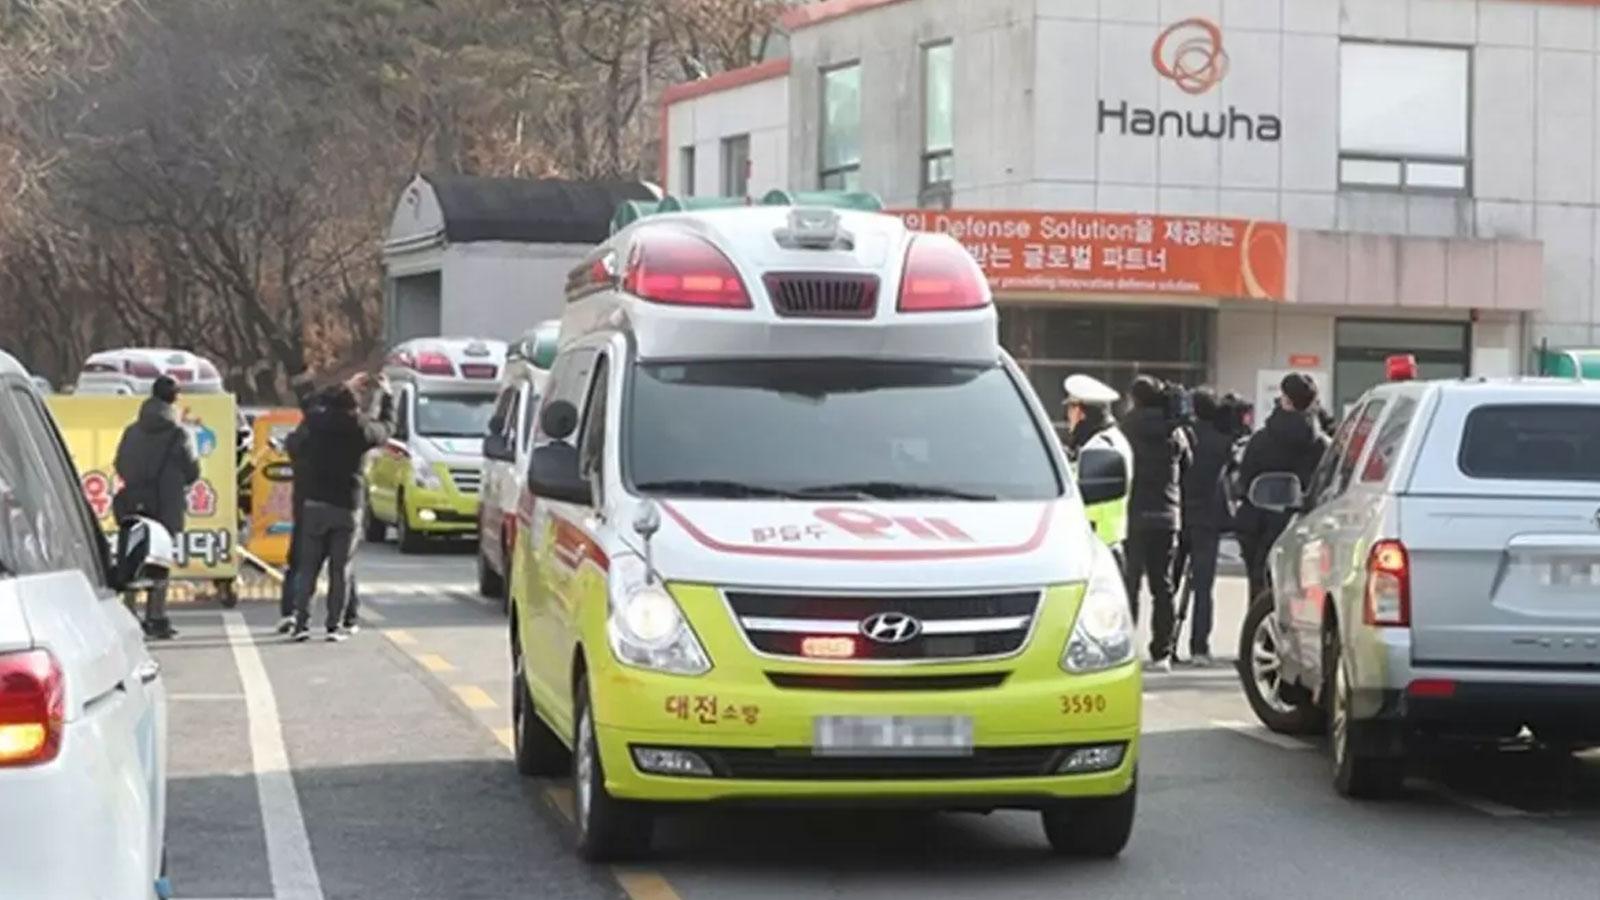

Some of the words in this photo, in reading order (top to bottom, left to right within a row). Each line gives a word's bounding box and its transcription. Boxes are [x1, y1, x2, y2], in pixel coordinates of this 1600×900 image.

[1097, 100, 1281, 142] Hanwha
[934, 214, 1032, 239] Defense
[1040, 215, 1153, 244] Solution을
[1164, 220, 1234, 247] 제공하는
[1023, 243, 1092, 270] 글로벌
[1103, 246, 1166, 272] 파트너
[664, 694, 717, 724] 대전
[1059, 693, 1107, 715] 3590
